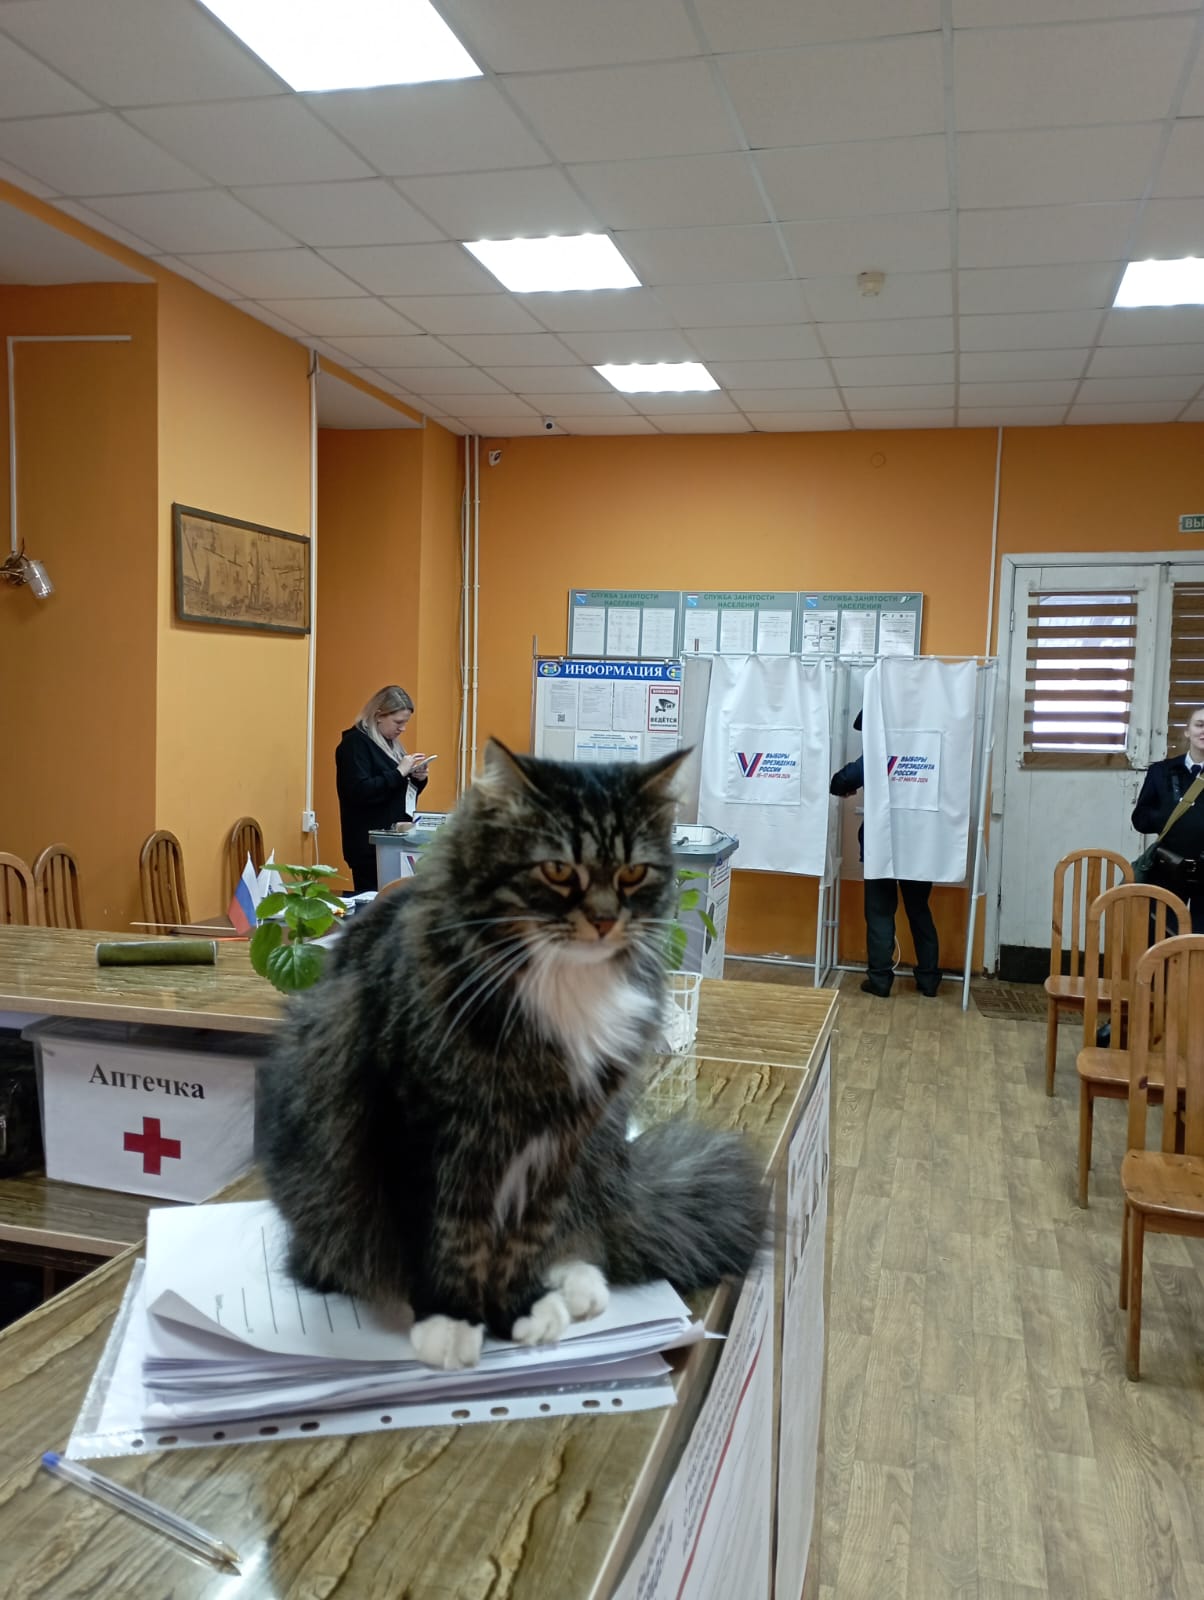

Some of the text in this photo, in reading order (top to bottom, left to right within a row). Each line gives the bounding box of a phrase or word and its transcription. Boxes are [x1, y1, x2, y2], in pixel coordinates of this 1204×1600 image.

[620, 592, 658, 600] ЗАНЯТОСТИ
[822, 594, 852, 602] СЛУЖБА
[565, 664, 663, 678] ИНФОРМАЦИЯ
[88, 1063, 205, 1100] Аптечка
